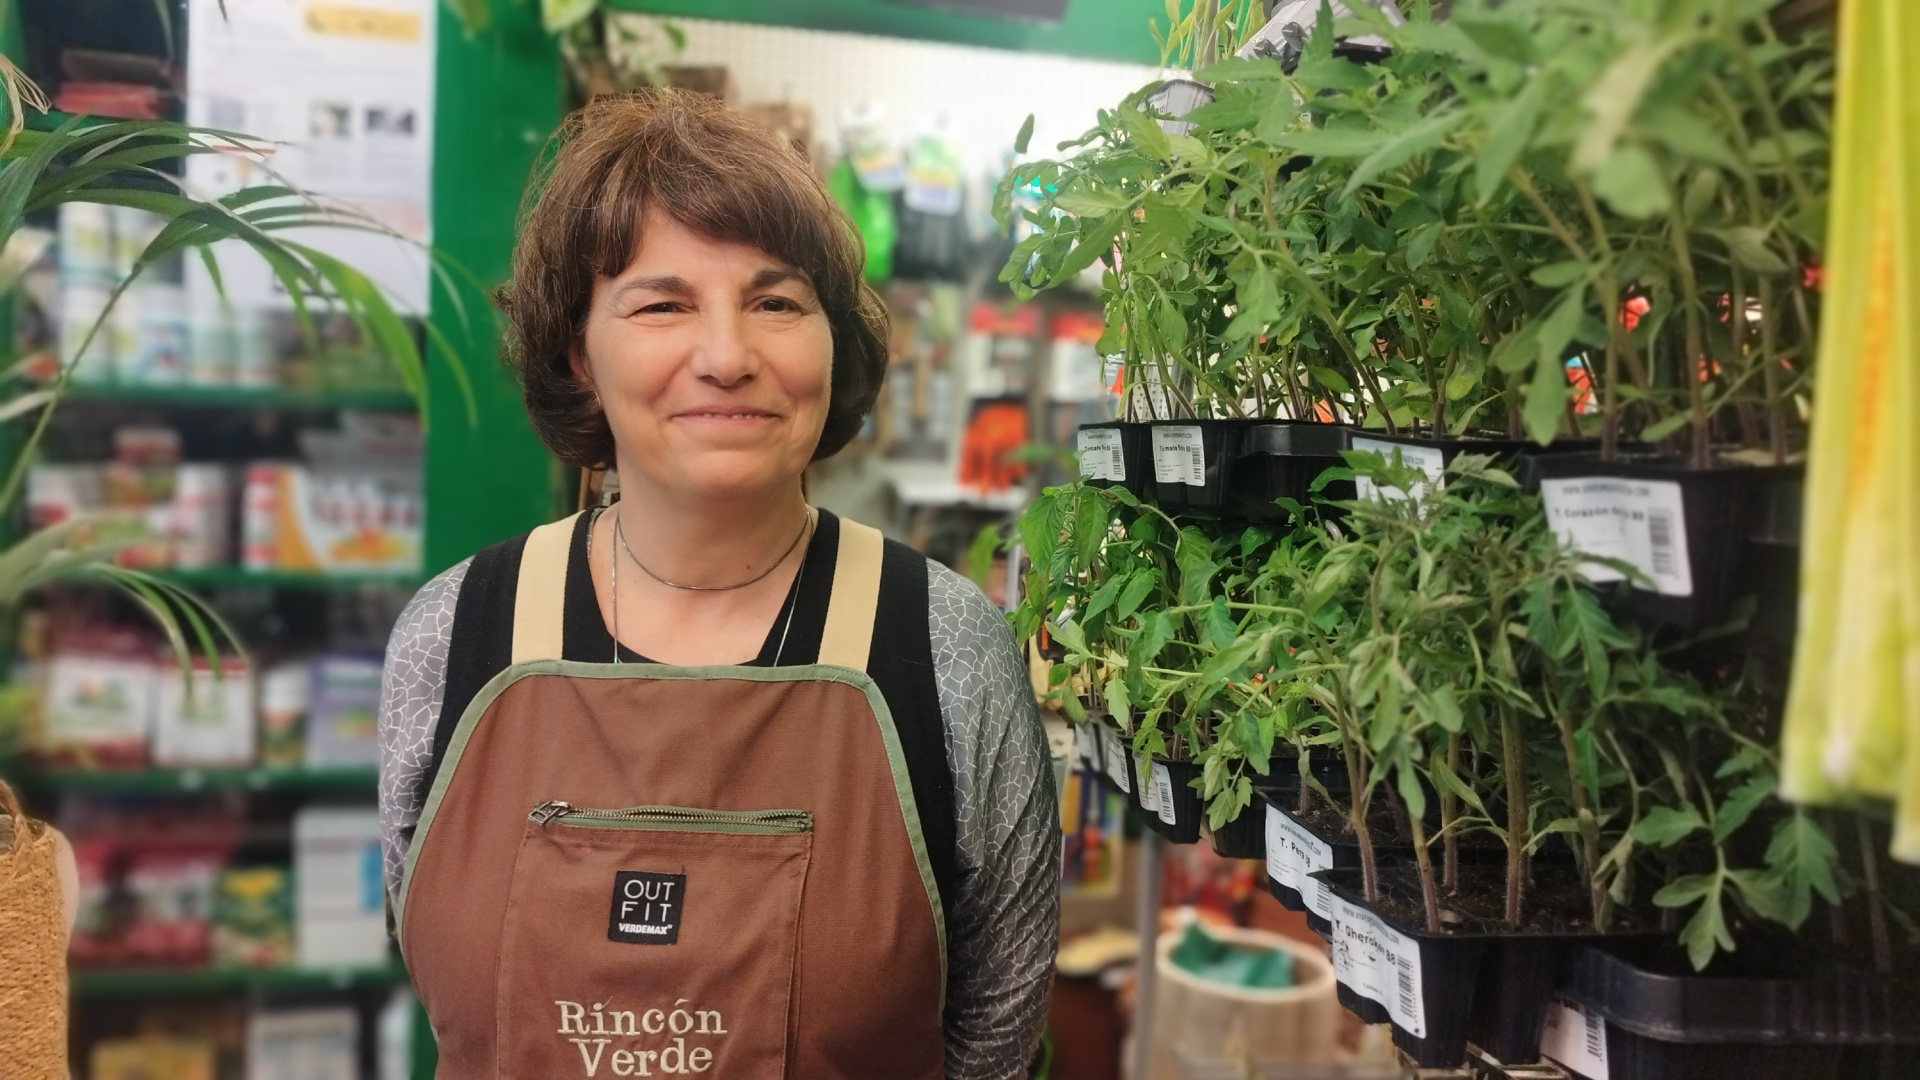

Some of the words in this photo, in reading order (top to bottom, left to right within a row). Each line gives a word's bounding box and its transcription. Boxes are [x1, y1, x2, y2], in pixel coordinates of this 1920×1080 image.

[1280, 836, 1288, 849] T.
[624, 879, 675, 901] OUT
[621, 901, 672, 922] FIT
[555, 998, 728, 1036] Rincón
[569, 1037, 713, 1077] Verde
